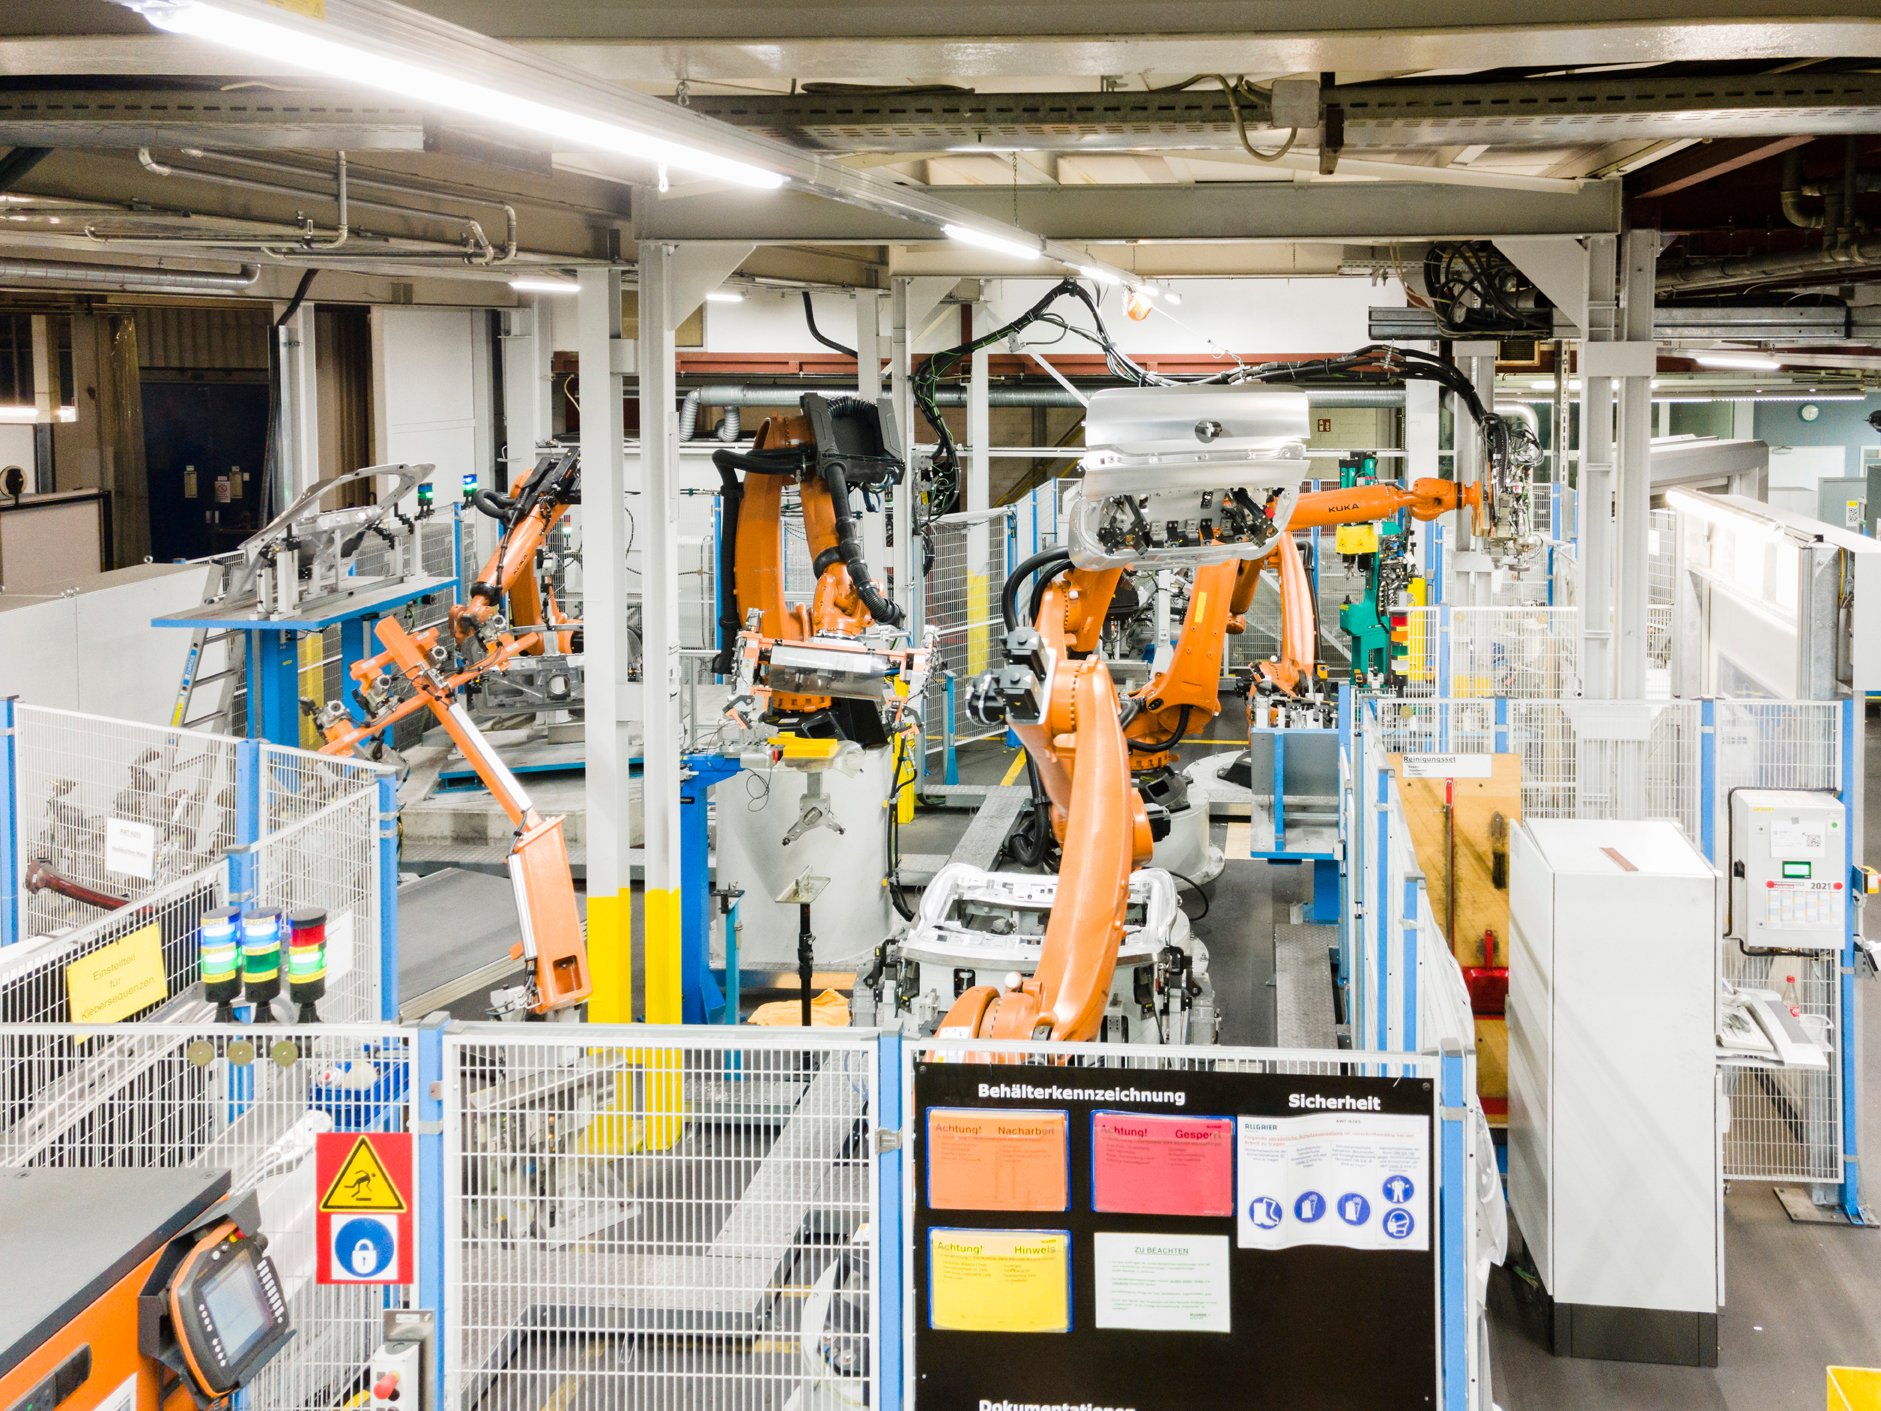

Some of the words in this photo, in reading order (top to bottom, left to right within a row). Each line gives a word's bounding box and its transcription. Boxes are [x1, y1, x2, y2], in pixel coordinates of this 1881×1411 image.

[1328, 503, 1359, 513] KUKA
[1403, 756, 1456, 764] Reinigungsset
[978, 1083, 1186, 1107] Behälterkennzeichnung
[1289, 1093, 1381, 1111] Sicherheit
[936, 1123, 982, 1135] Achtung!
[998, 1126, 1055, 1136] Nacharbeit
[937, 1241, 983, 1255] Achtung!
[1014, 1245, 1056, 1255] Hinweis
[1134, 1247, 1145, 1255] ZU
[1147, 1247, 1189, 1255] BEACHTEN
